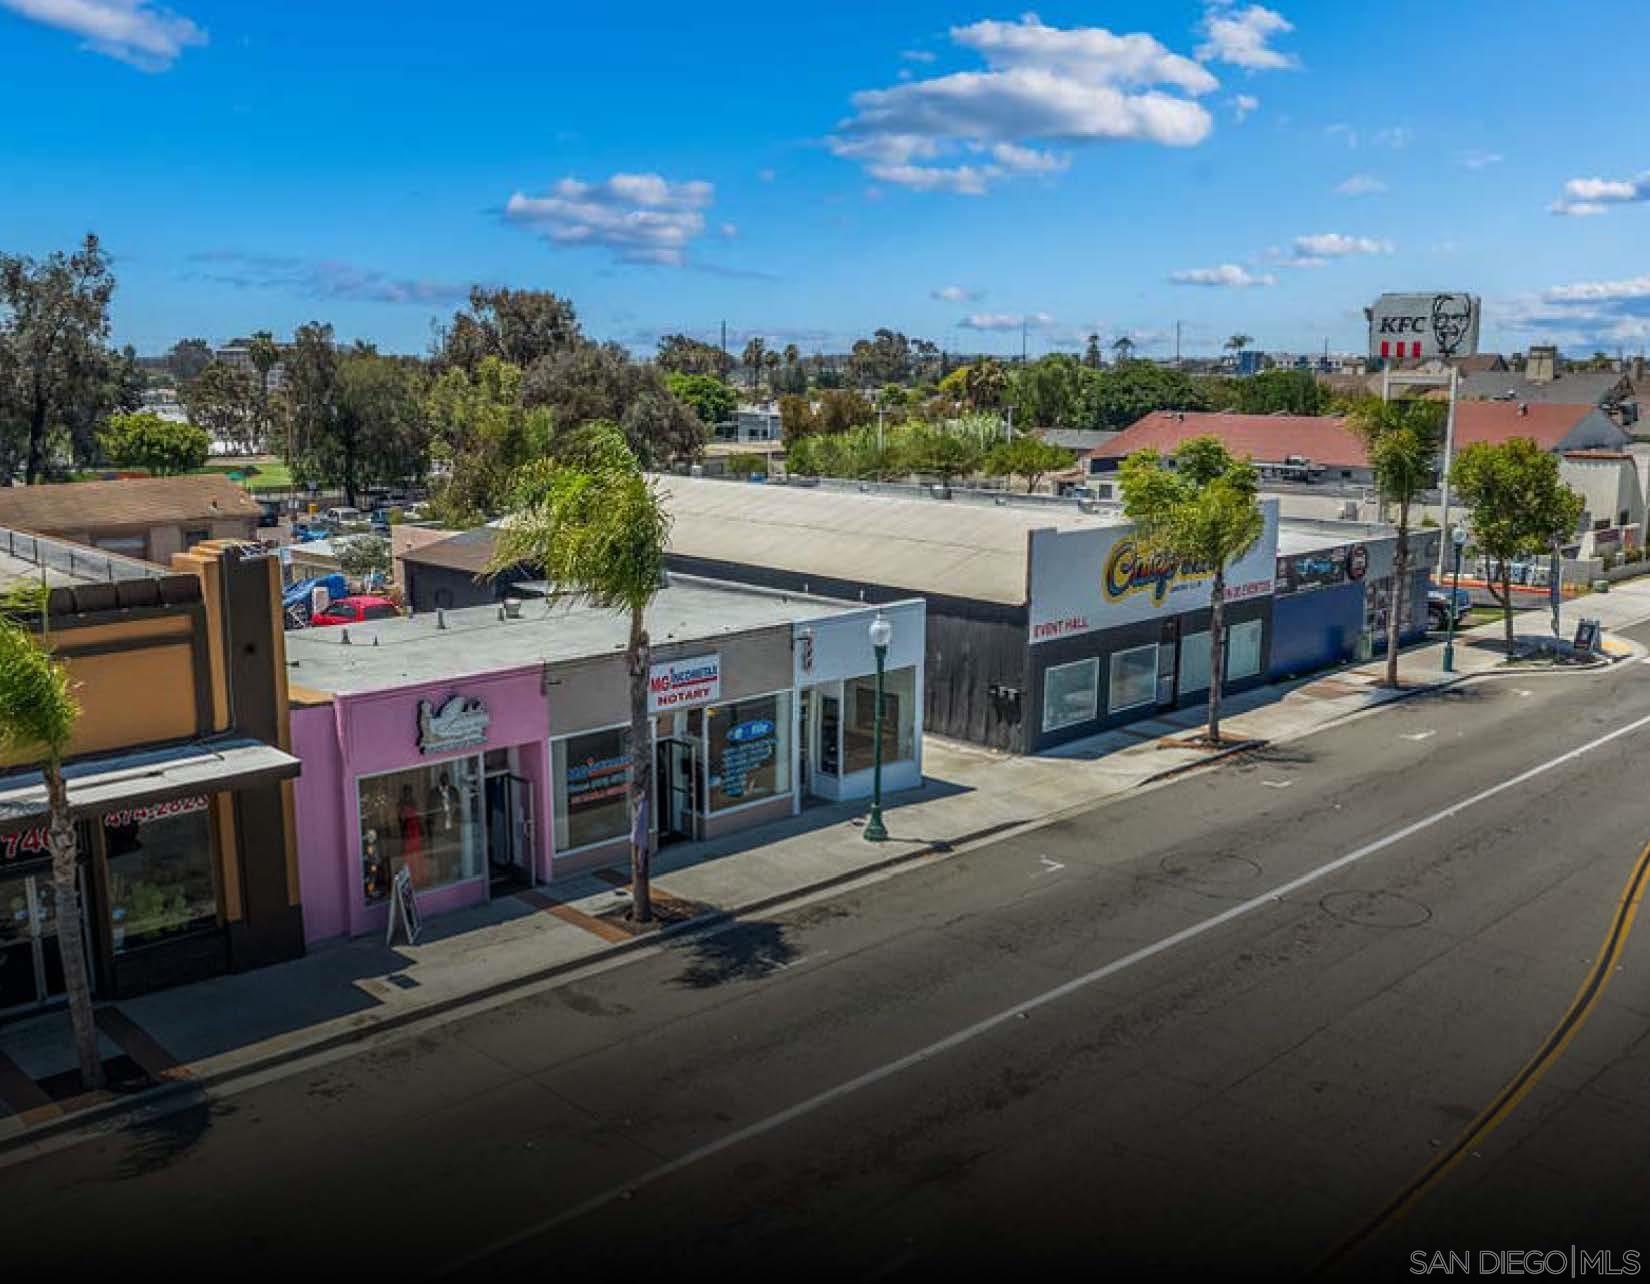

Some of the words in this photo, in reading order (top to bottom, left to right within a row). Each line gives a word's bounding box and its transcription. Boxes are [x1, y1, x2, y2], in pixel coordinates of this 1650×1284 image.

[1379, 316, 1427, 333] KFC
[1033, 619, 1064, 638] EVENT
[1064, 615, 1090, 630] HALL
[657, 688, 709, 706] NOTARY
